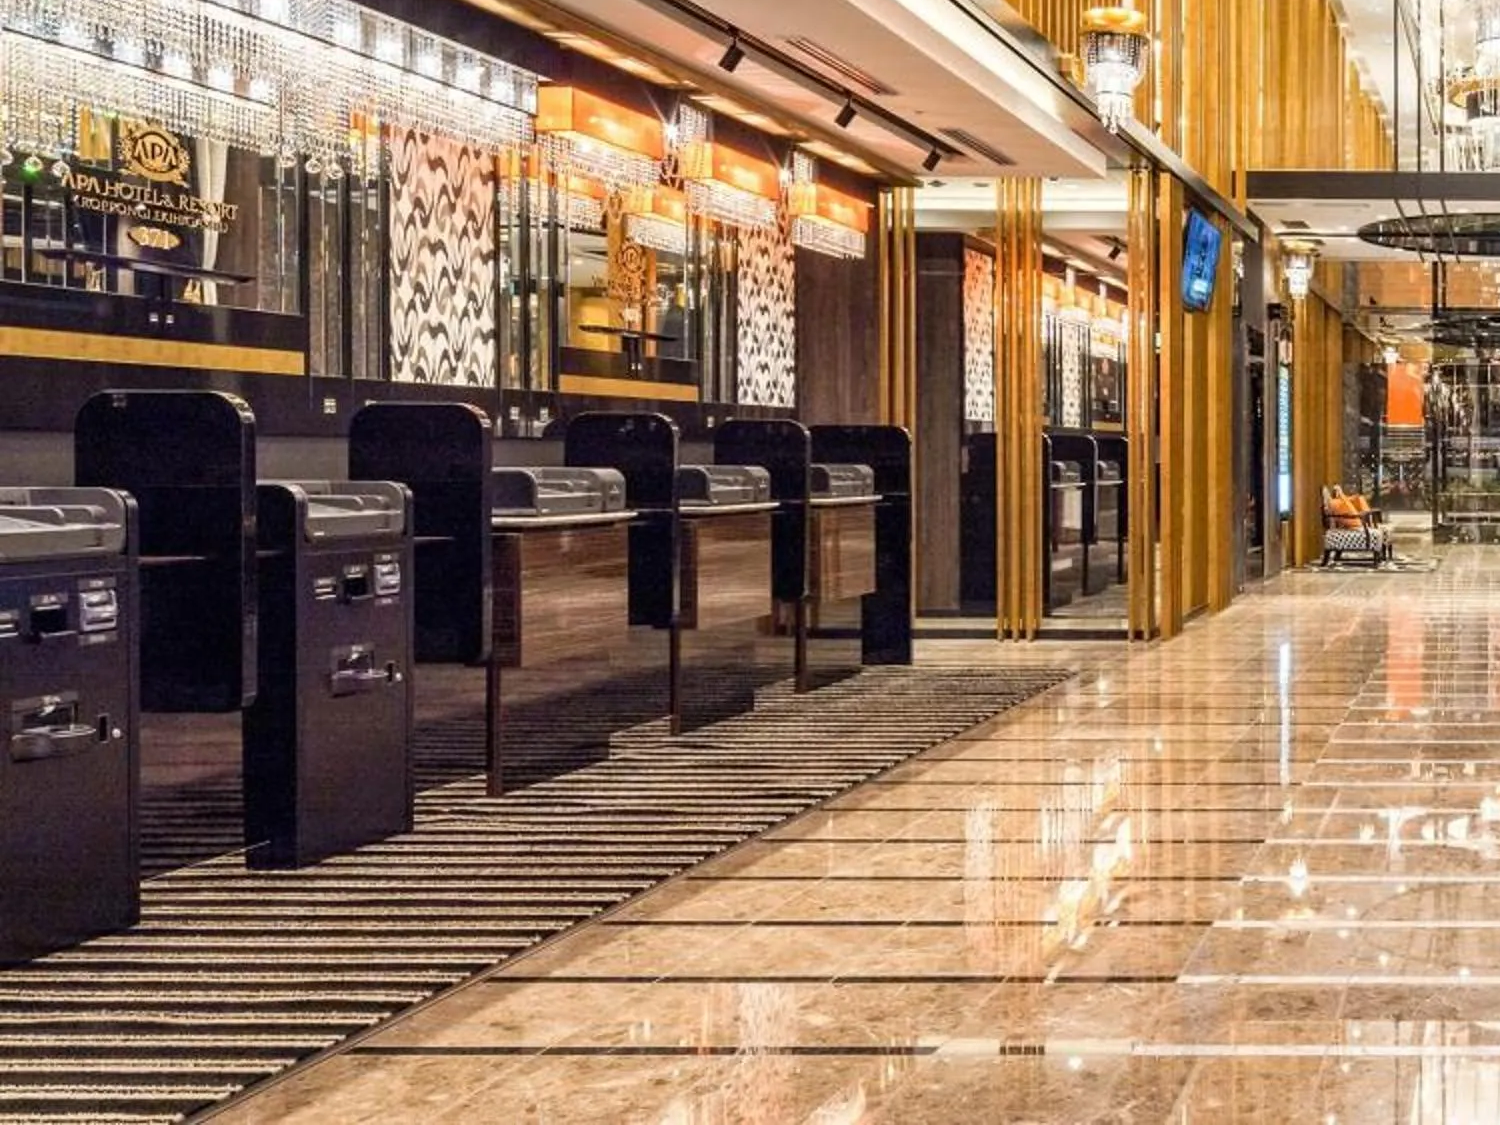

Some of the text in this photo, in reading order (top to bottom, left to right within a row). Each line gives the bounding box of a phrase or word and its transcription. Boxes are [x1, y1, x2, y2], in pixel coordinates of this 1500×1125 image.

[134, 137, 177, 165] APA
[61, 171, 100, 195] APA
[101, 178, 163, 206] HOTEL
[160, 194, 174, 208] &
